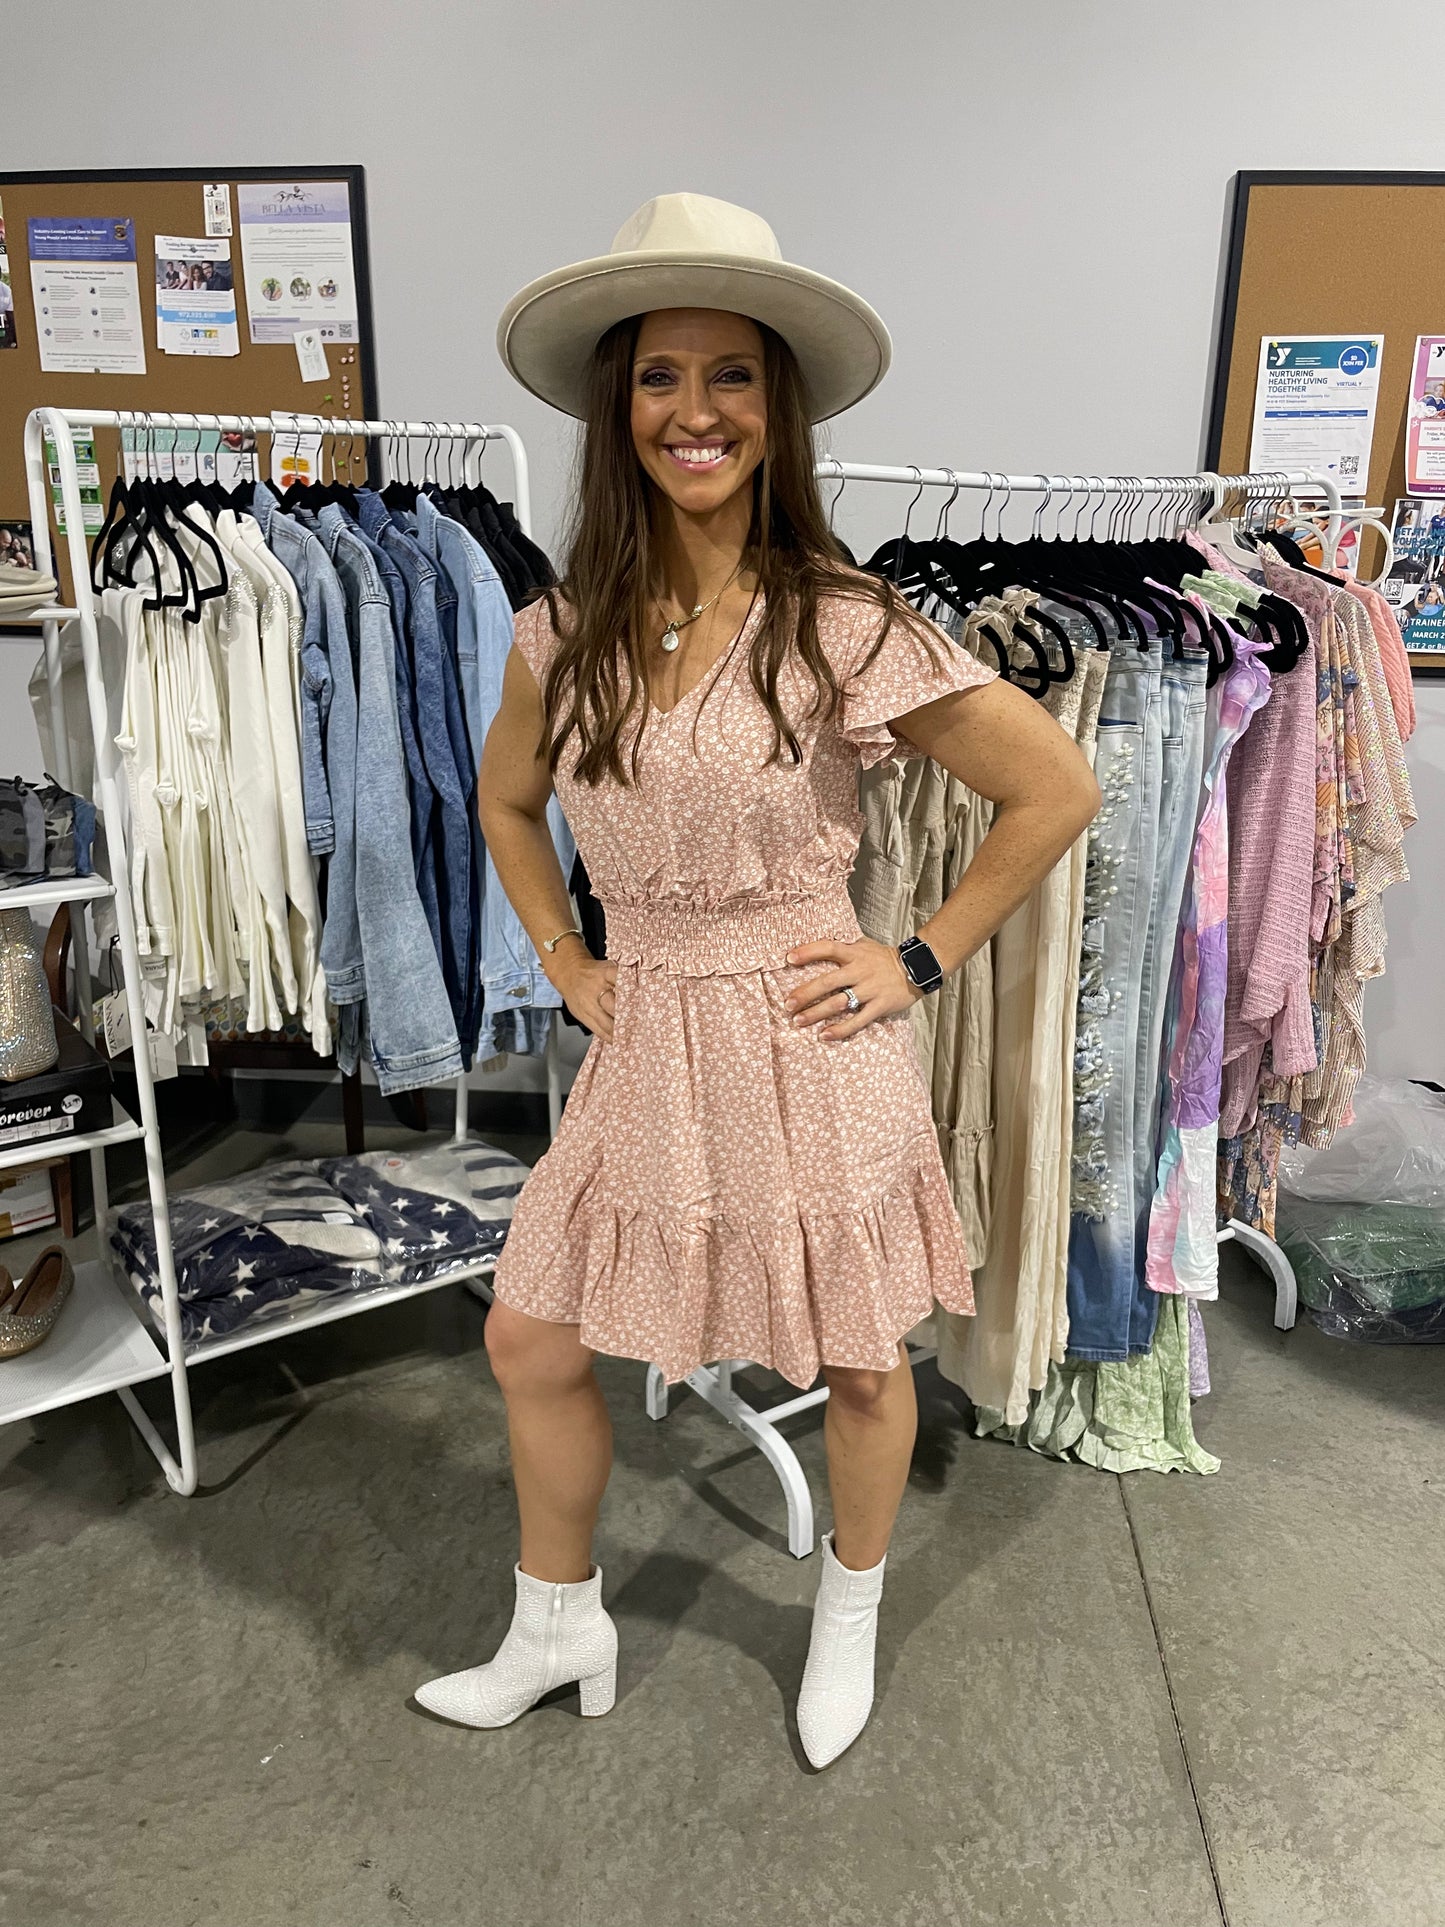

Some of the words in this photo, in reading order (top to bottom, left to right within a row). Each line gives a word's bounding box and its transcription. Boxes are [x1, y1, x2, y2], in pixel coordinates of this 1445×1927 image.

[262, 204, 293, 214] BELLA
[297, 204, 327, 214] VISTA
[1269, 370, 1314, 378] NURTURING
[1268, 378, 1302, 386] HEALTHY
[1303, 377, 1328, 385] LIVING
[1267, 385, 1307, 393] TOGETHER
[104, 1002, 117, 1053] ZENANA
[0, 1106, 52, 1126] orever
